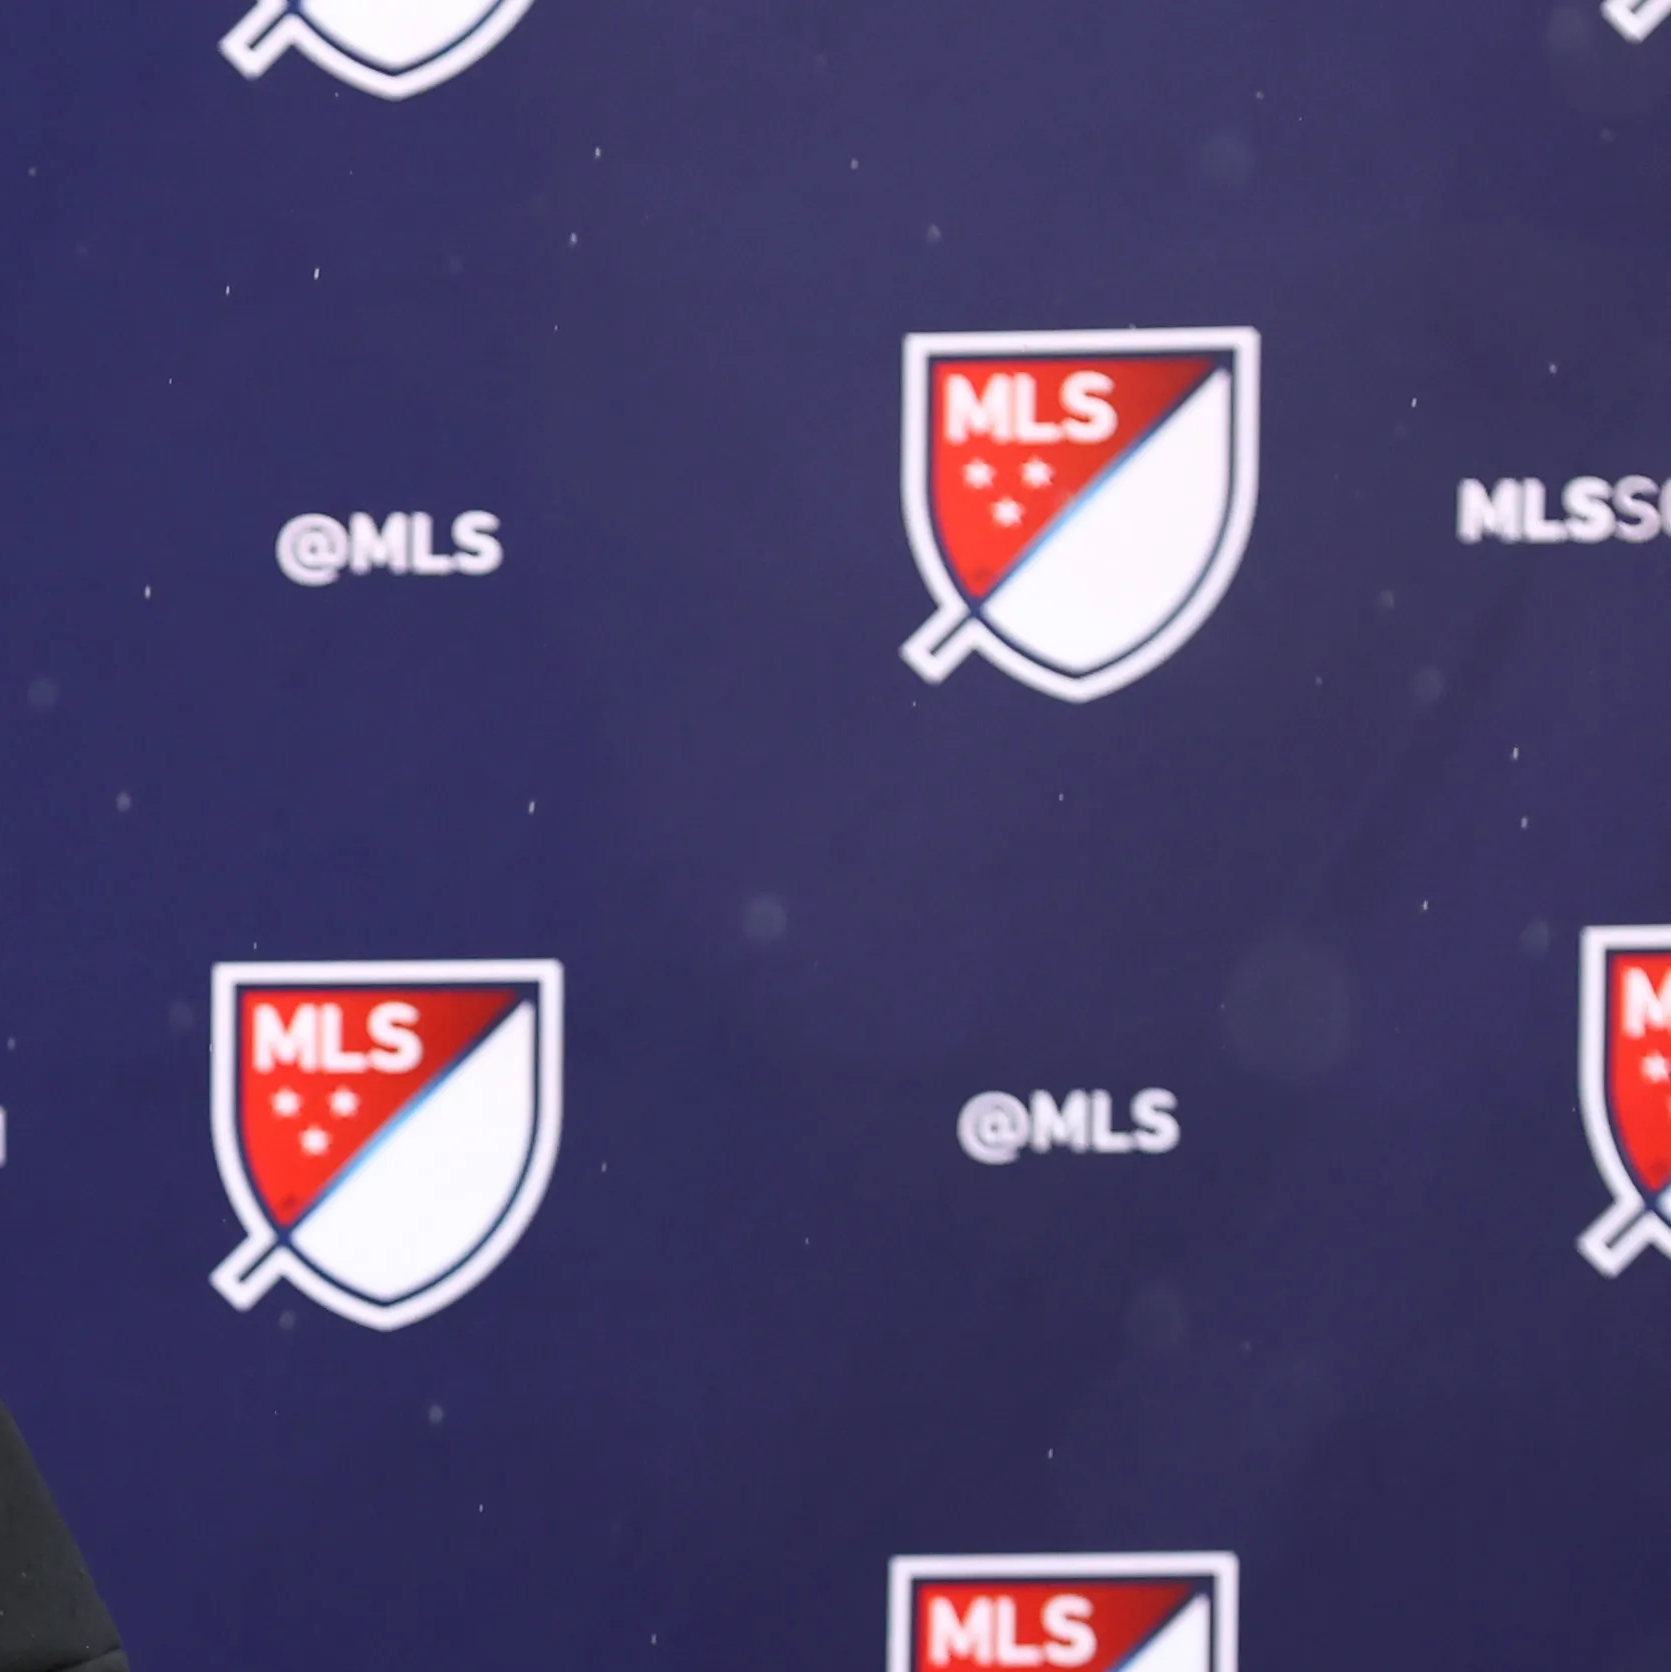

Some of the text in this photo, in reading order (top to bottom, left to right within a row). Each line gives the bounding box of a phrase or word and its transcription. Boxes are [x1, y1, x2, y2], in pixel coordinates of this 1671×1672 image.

[943, 369, 1119, 446] MLS
[1456, 473, 1671, 544] MLSS
[274, 508, 504, 587] @MLS
[252, 1000, 424, 1075] MLS
[956, 1086, 1181, 1166] @MLS
[927, 1593, 1098, 1668] MLS
